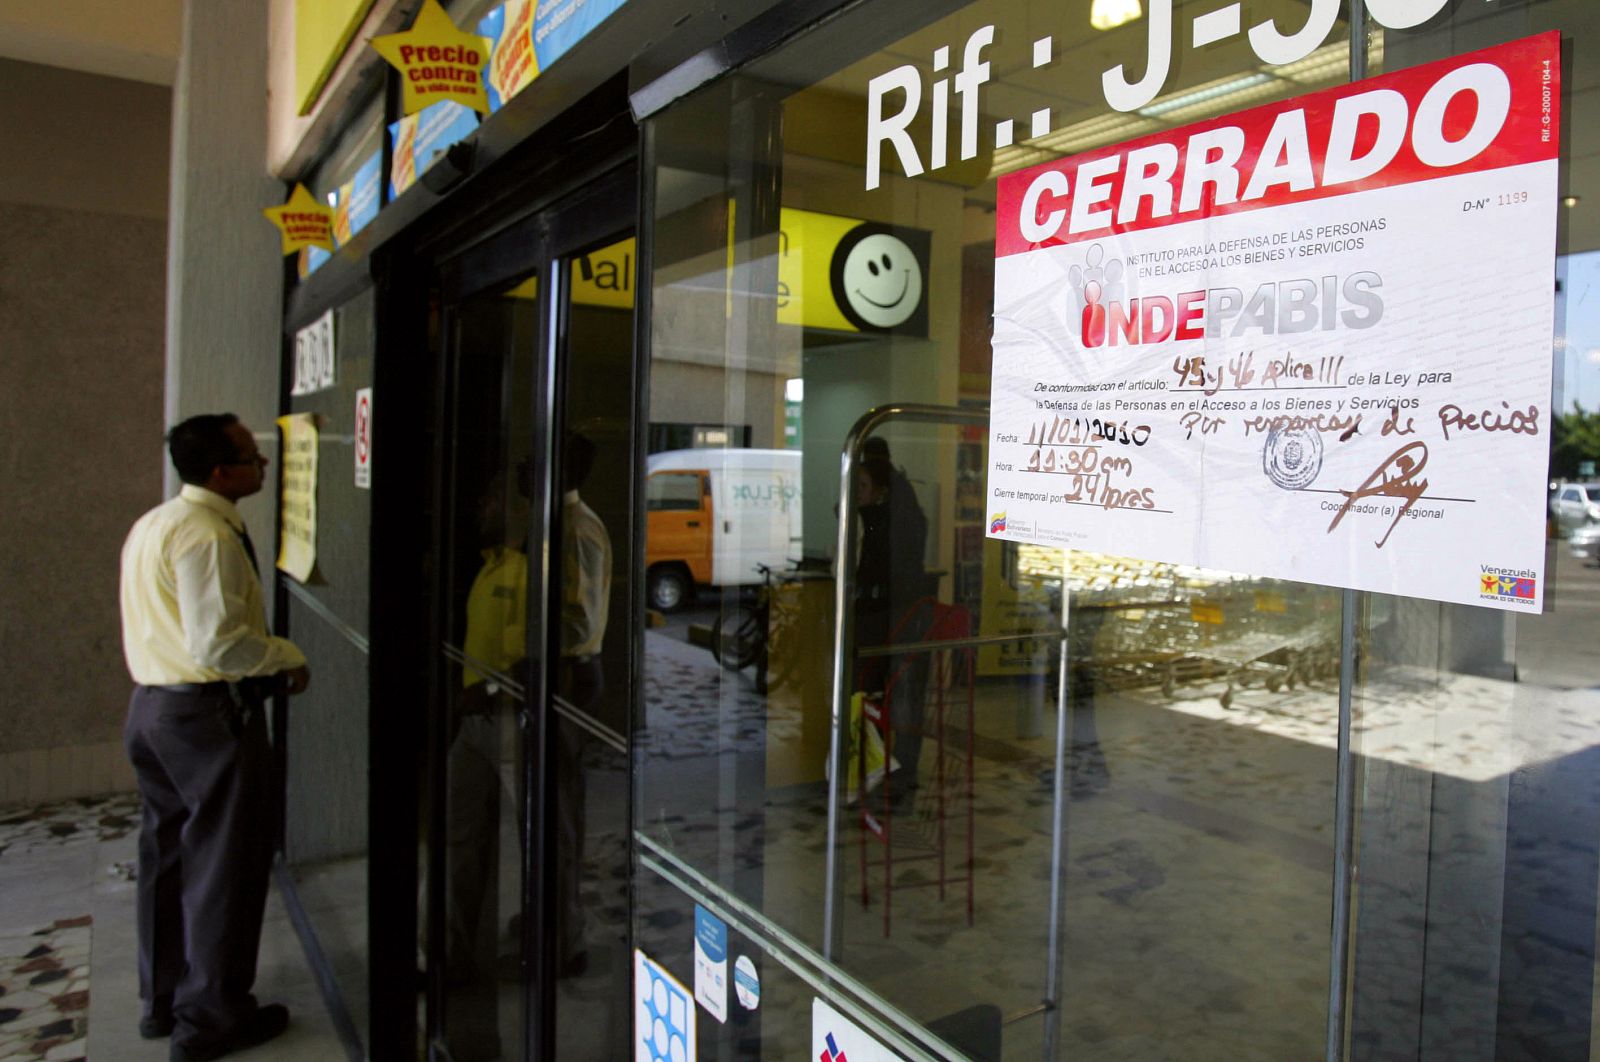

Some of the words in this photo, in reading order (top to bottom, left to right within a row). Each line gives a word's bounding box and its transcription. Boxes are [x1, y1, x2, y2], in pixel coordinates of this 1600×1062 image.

[400, 44, 479, 66] Precio
[408, 66, 477, 83] contra
[1019, 62, 1512, 243] CERRADO
[1498, 191, 1528, 206] 1199
[1126, 249, 1175, 267] INSTITUTO
[1177, 245, 1203, 259] PARA
[1204, 242, 1217, 255] LA
[1219, 235, 1270, 253] DEFENSA
[1272, 232, 1288, 245] DE
[1291, 228, 1314, 242] LAS
[1316, 217, 1387, 239] PERSONAS
[1139, 267, 1152, 278] EN
[1154, 265, 1166, 276] EL
[1168, 258, 1209, 274] ACCESO
[1210, 257, 1218, 268] A
[1220, 254, 1241, 267] LOS
[1244, 248, 1285, 264] BIENES
[1288, 247, 1296, 258] Y
[1298, 237, 1365, 257] SERVICIOS
[1034, 382, 1048, 392] De
[1048, 383, 1100, 393] conformidad
[1100, 383, 1116, 392] con
[1117, 380, 1126, 390] el
[1348, 373, 1365, 386] de
[1368, 371, 1381, 385] la
[1385, 371, 1411, 388] Ley
[1417, 371, 1452, 387] para
[1044, 400, 1078, 410] Defensa
[1081, 400, 1092, 410] de
[1096, 399, 1111, 410] las
[1115, 399, 1167, 410] Personas
[1170, 402, 1185, 410] en
[1188, 399, 1200, 410] el
[1201, 399, 1246, 411] Acceso
[1250, 401, 1257, 410] a
[1262, 398, 1280, 410] los
[1285, 397, 1332, 410] Bienes
[1336, 400, 1345, 412] y
[1349, 396, 1420, 409] Servicios
[995, 461, 1014, 472] Hora:
[994, 487, 1015, 498] Cierre
[1016, 489, 1049, 502] temporal
[1320, 500, 1379, 514] Coorinador
[1381, 506, 1395, 517] (a)
[1480, 564, 1537, 579] Venezuela
